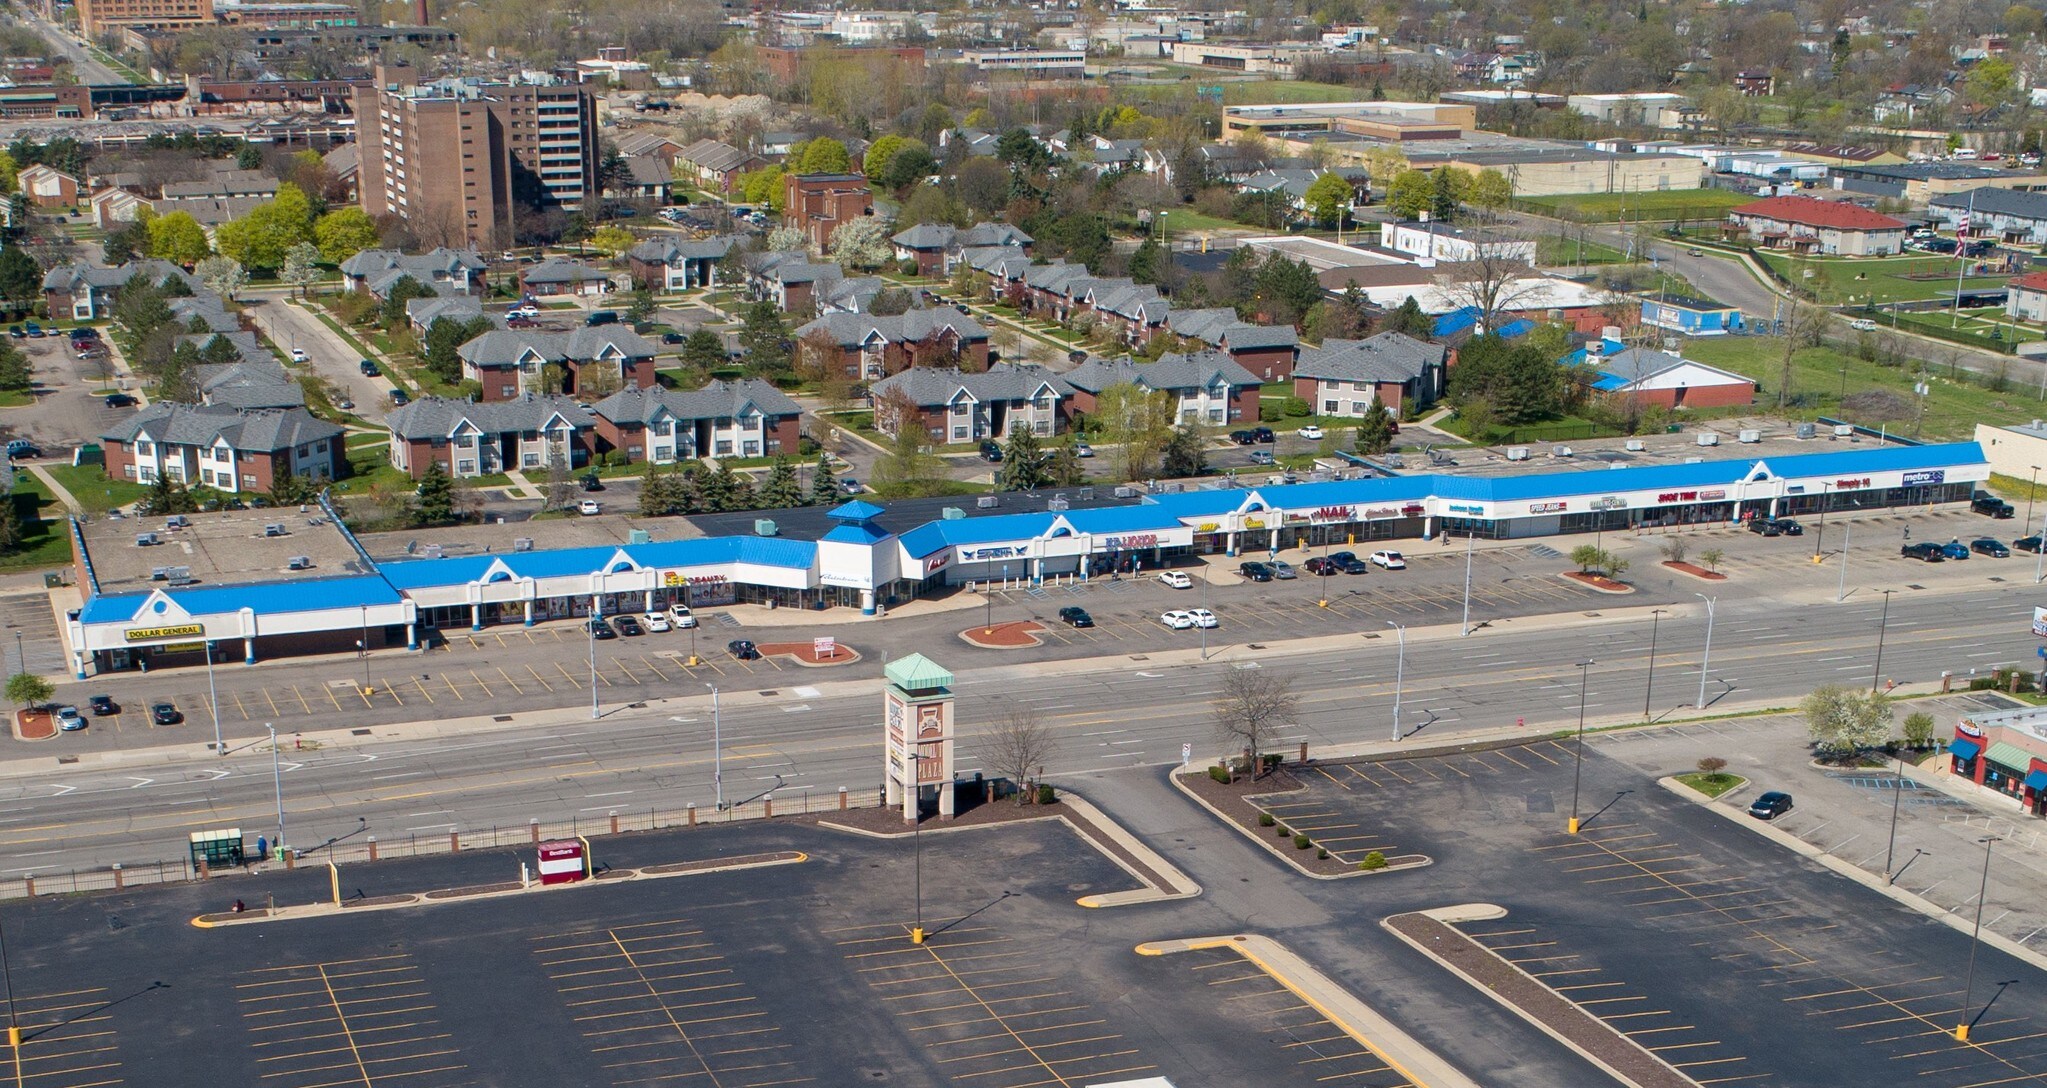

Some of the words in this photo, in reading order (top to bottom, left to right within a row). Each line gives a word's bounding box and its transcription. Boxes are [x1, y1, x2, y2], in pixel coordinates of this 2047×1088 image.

[129, 629, 160, 638] DOLLAR
[162, 626, 198, 635] GENERAL
[918, 762, 943, 779] PLAZA
